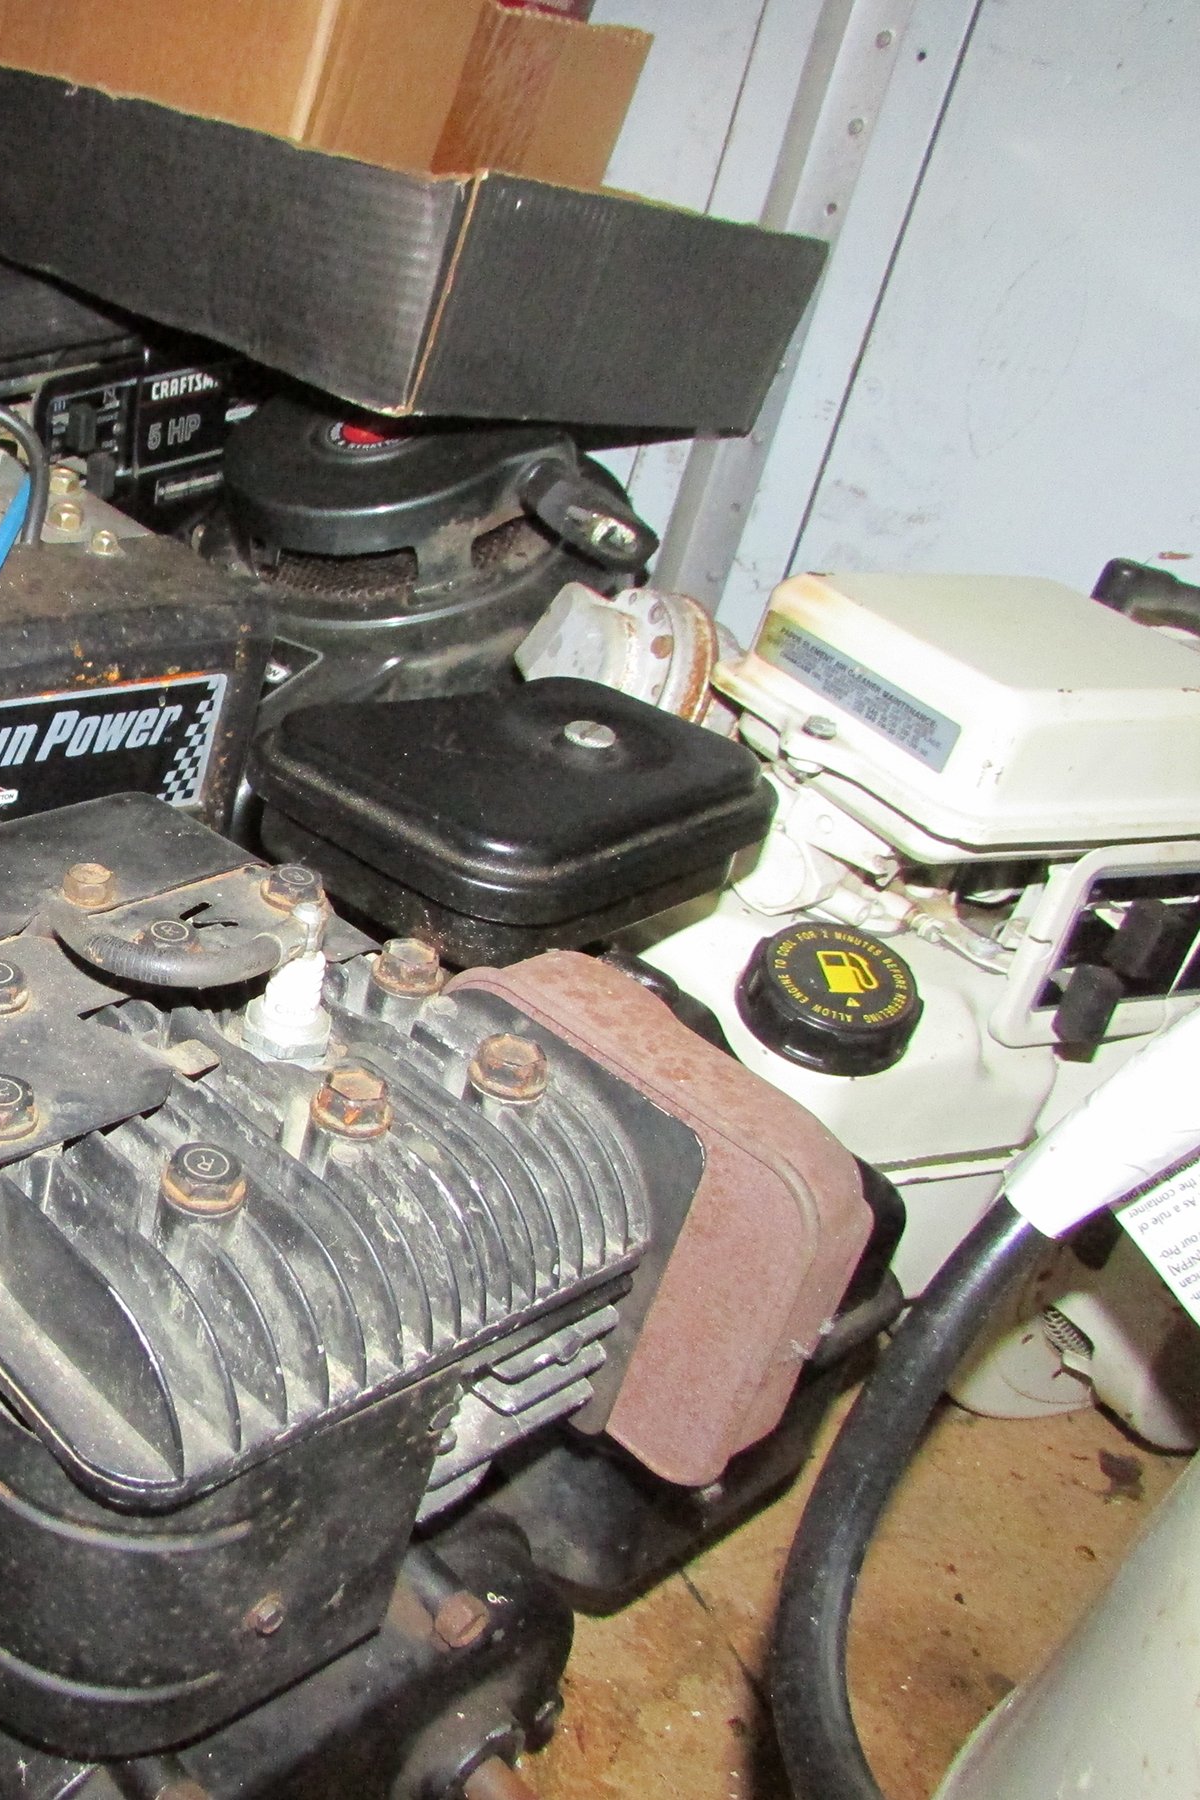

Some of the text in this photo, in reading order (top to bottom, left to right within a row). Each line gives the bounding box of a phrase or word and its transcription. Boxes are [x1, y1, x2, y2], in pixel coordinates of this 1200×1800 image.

[151, 373, 219, 400] CRAFTSM
[167, 413, 201, 446] HP
[35, 704, 183, 762] Power
[774, 929, 909, 1024] ALLOW ENGINE TO COOL FOR 2 MINUTES BEFORE REFUELING
[1128, 1178, 1198, 1218] the container
[1139, 1177, 1159, 1196] and
[1182, 1196, 1197, 1208] As
[1138, 1222, 1149, 1235] of
[1151, 1210, 1172, 1225] rule
[1159, 1234, 1199, 1258] our Pro-
